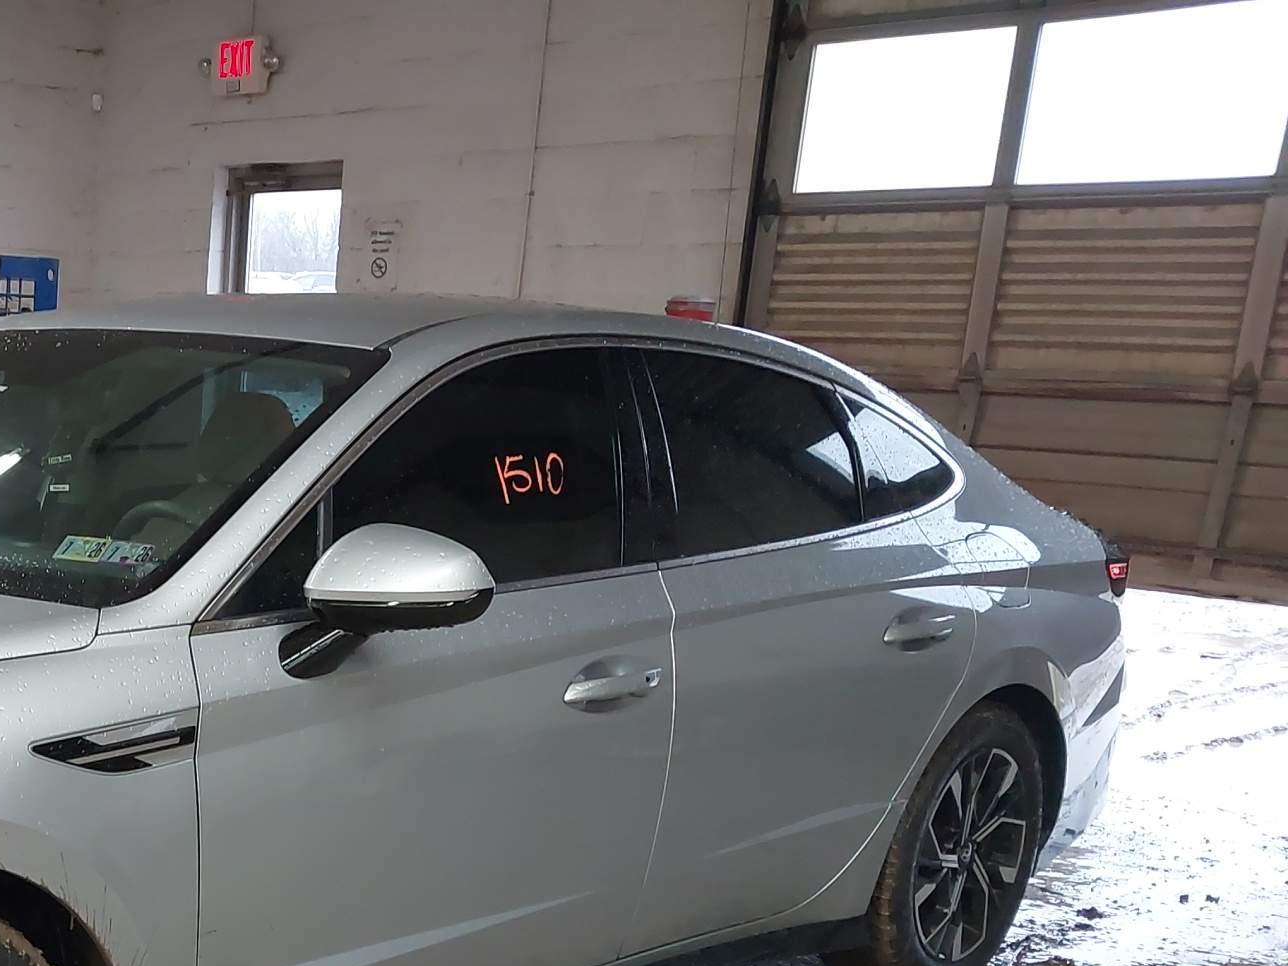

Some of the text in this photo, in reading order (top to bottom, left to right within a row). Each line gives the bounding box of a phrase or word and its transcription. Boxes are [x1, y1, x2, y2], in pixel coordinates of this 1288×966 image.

[219, 40, 254, 78] EXIT
[494, 452, 564, 505] 1510
[86, 541, 107, 558] 26
[134, 546, 153, 563] 26
